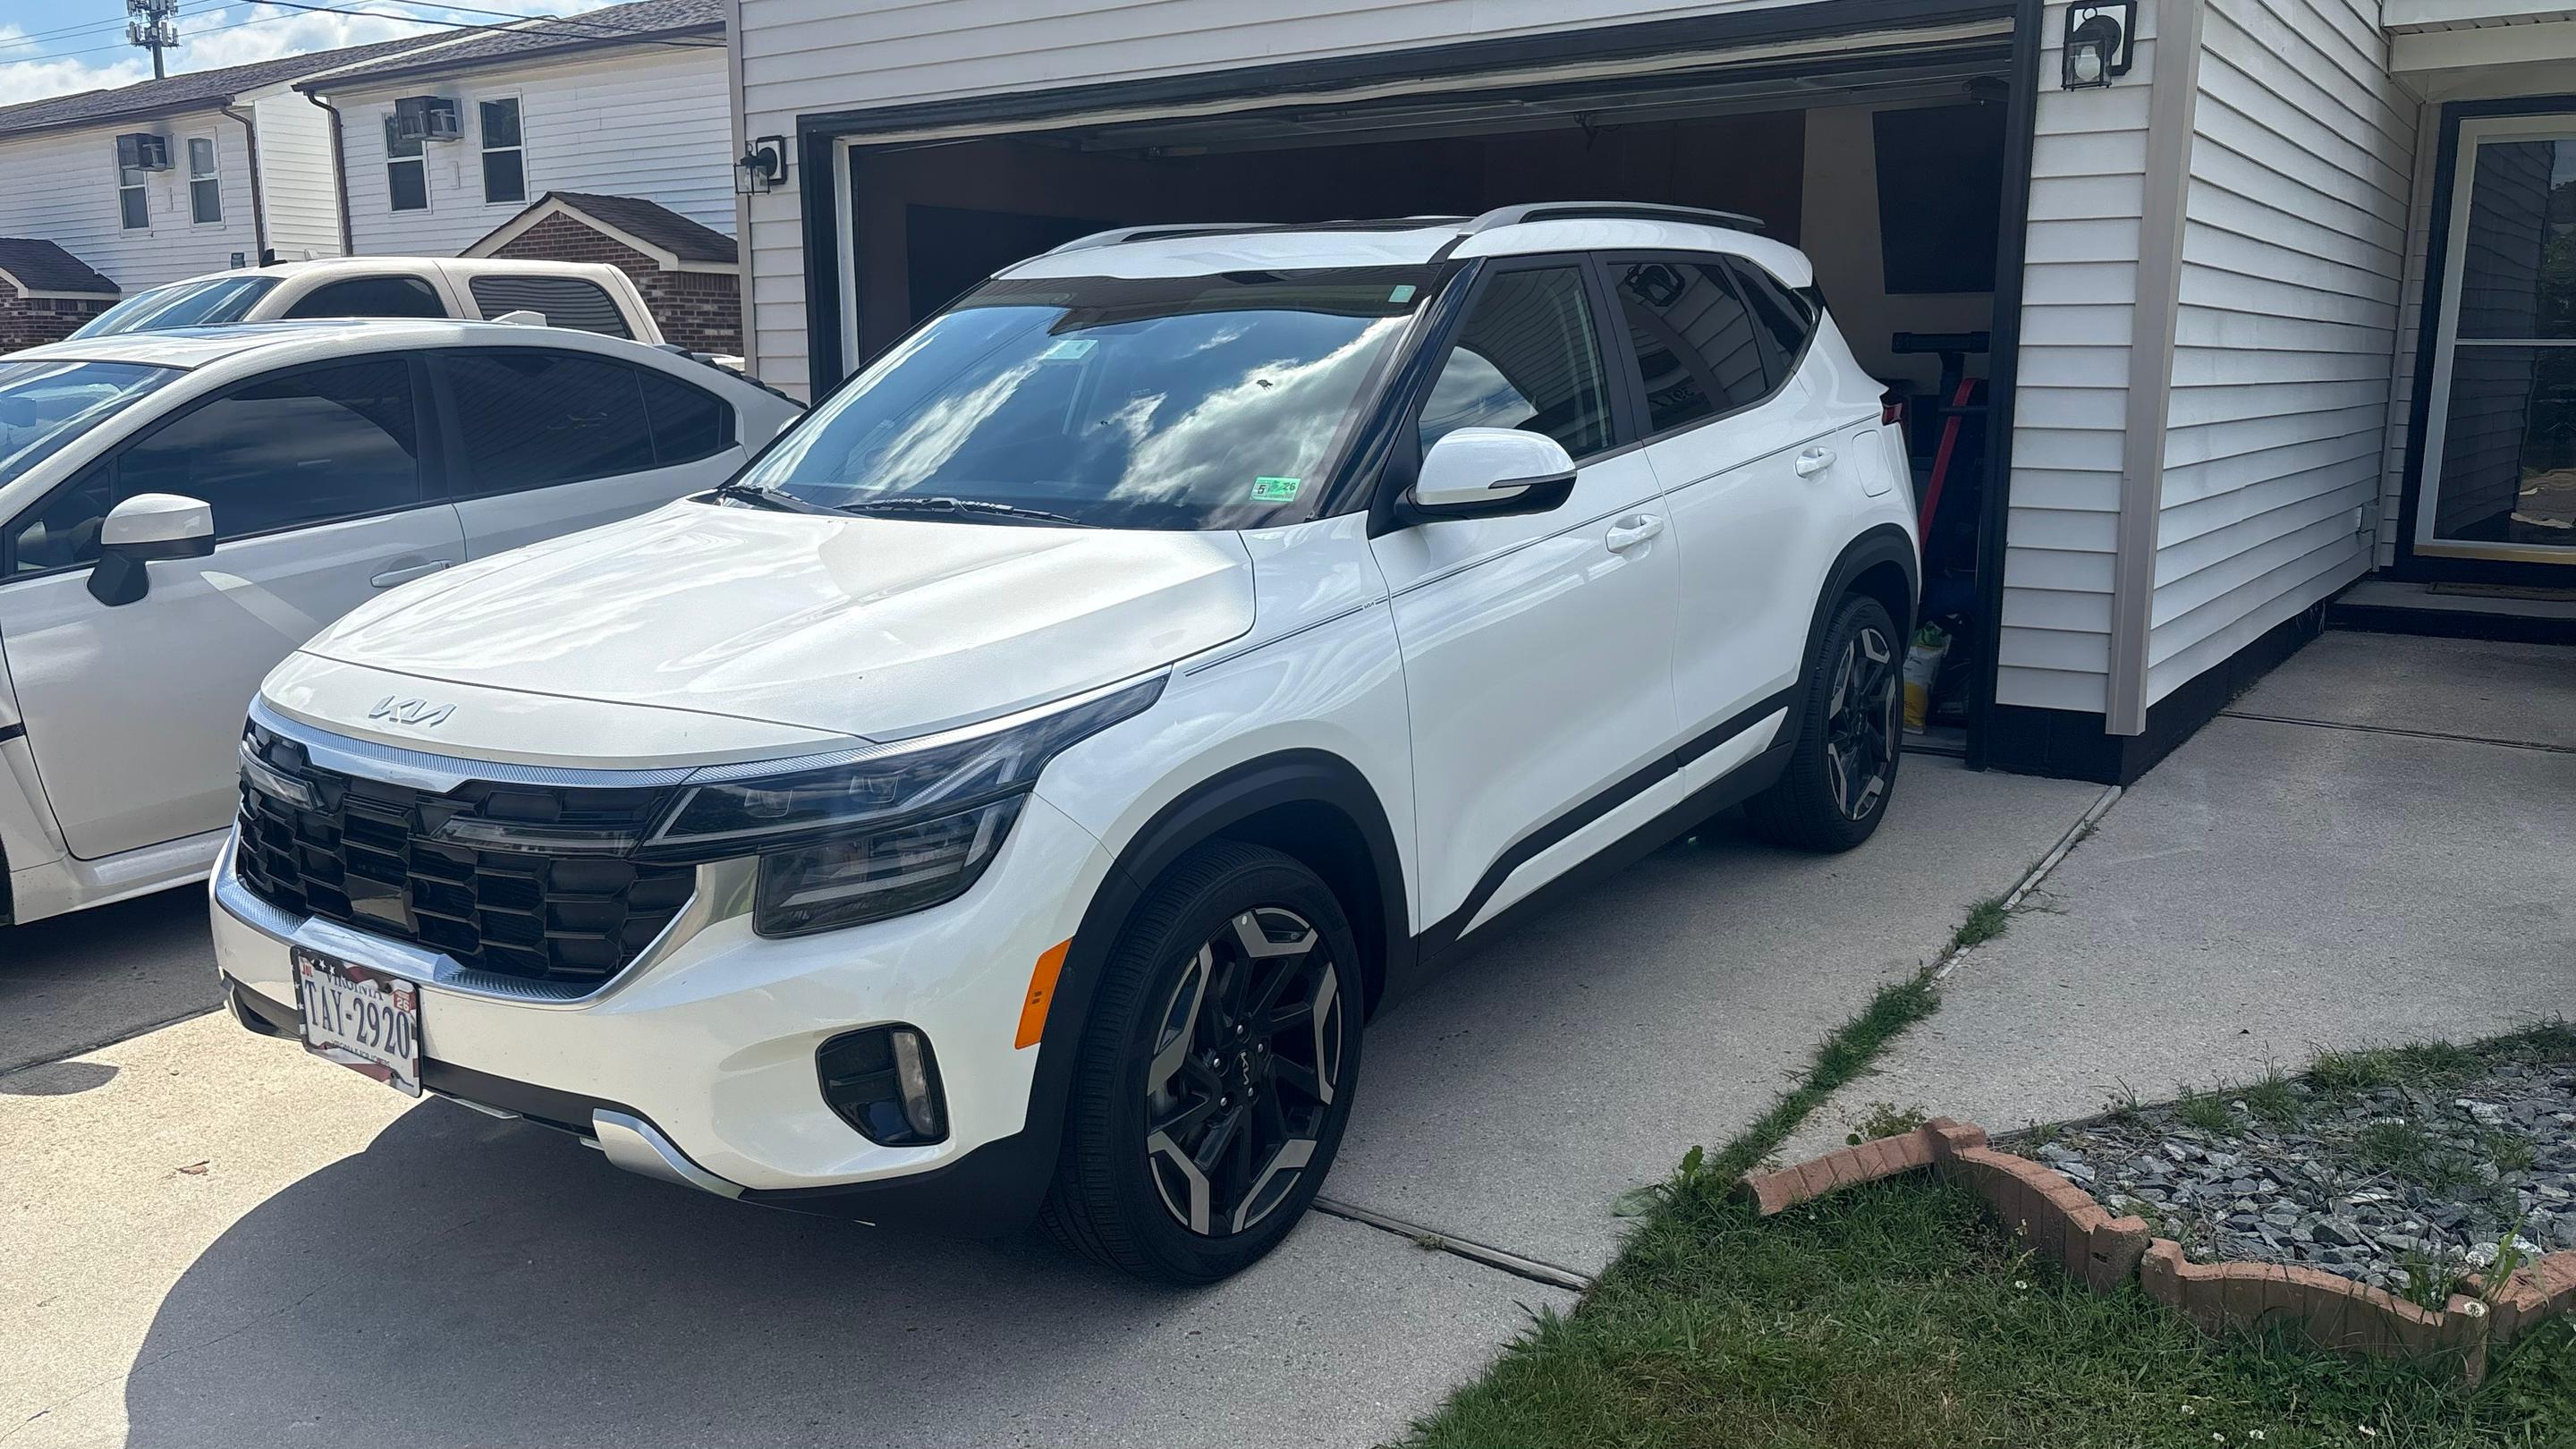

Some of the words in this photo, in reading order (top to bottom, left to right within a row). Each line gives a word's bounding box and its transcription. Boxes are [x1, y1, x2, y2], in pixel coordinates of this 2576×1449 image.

[1283, 482, 1296, 491] 26
[368, 694, 458, 728] KIA
[301, 963, 313, 978] JUL
[396, 996, 410, 1012] 26
[305, 979, 411, 1060] TAY-2920
